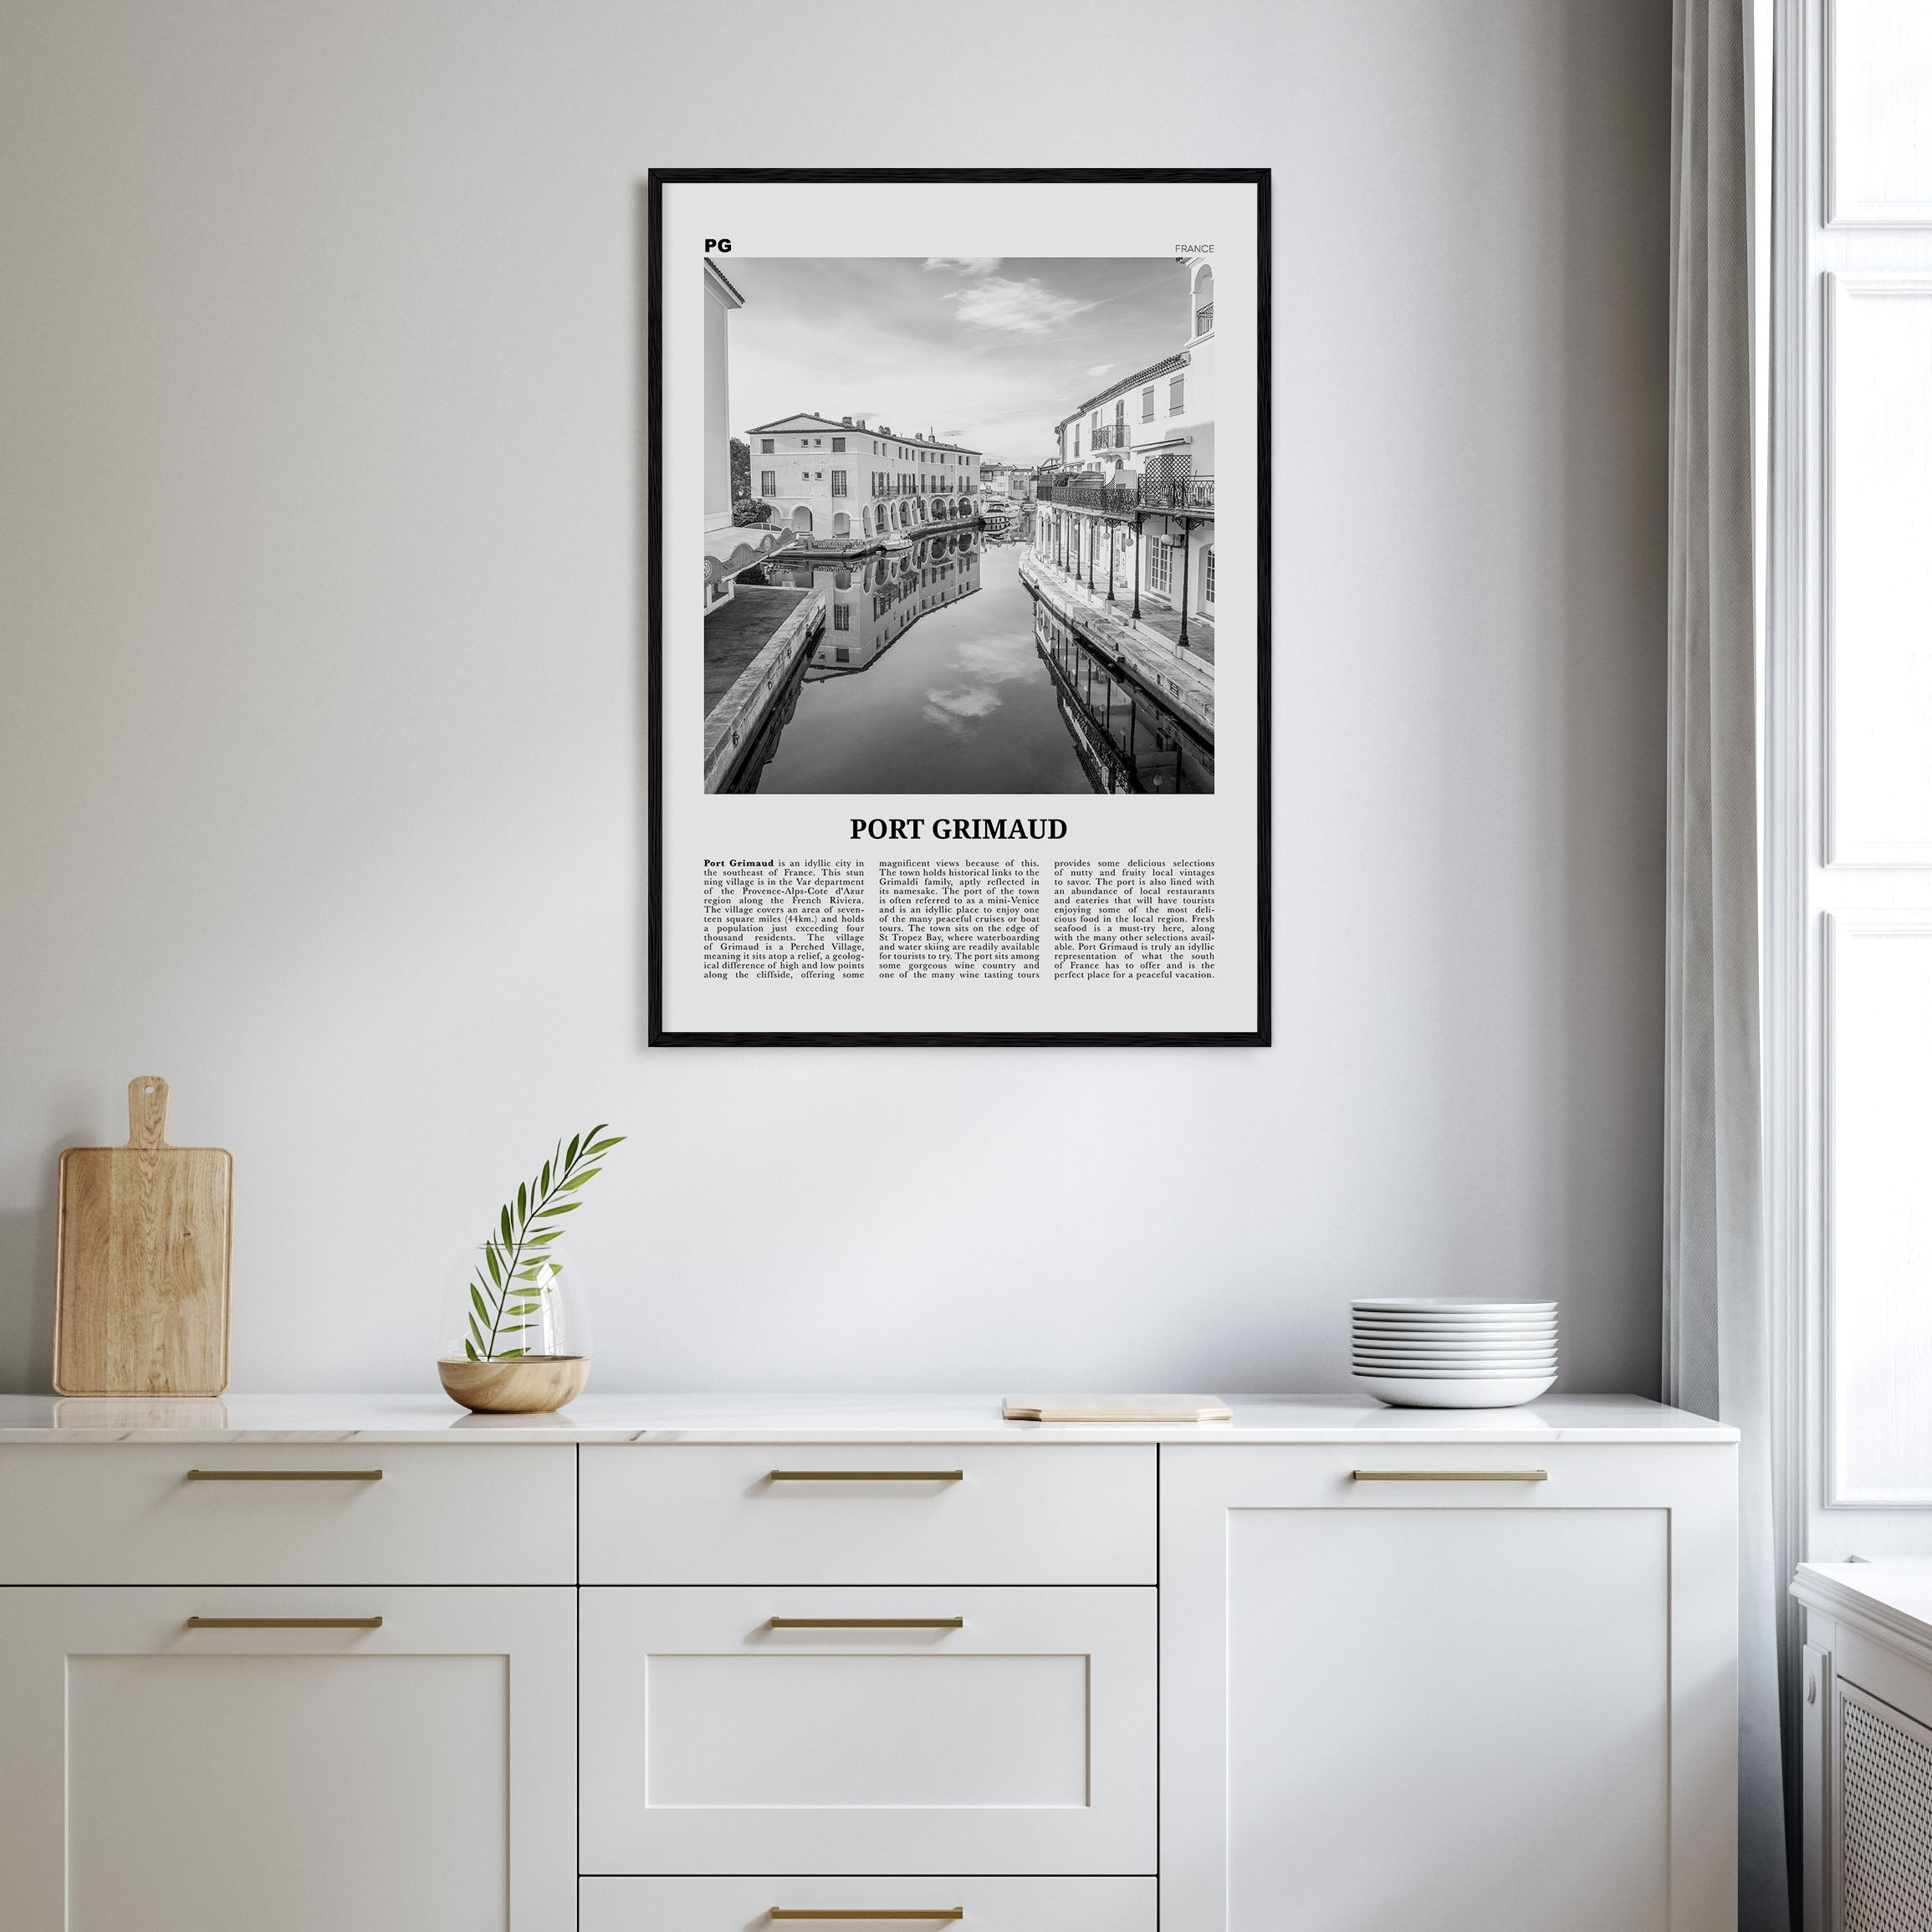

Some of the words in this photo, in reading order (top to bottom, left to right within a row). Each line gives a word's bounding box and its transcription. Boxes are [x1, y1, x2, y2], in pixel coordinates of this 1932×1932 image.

[704, 238, 732, 253] PG
[1174, 244, 1215, 253] FRANCE
[850, 818, 925, 840] PORT
[932, 818, 1068, 840] GRIMAUD
[703, 859, 725, 867] Port
[729, 859, 774, 867] Grimaud
[778, 859, 785, 867] is
[805, 859, 831, 869] idyllic
[835, 859, 851, 869] city
[856, 859, 864, 867] in
[879, 859, 930, 869] magnificent
[936, 859, 960, 867] views
[965, 859, 999, 867] because
[1005, 859, 1015, 867] of
[1021, 859, 1039, 867] this.
[1054, 859, 1091, 869] provides
[1127, 859, 1166, 867] delicious
[1173, 859, 1215, 867] selections
[704, 868, 718, 877] the
[723, 868, 763, 877] southeast
[768, 868, 779, 877] of
[784, 868, 815, 877] France.
[820, 868, 841, 877] This
[1054, 868, 1064, 877] of
[1071, 870, 1093, 878] nutty
[1099, 868, 1116, 877] and
[1122, 868, 1146, 878] fruity
[1153, 868, 1173, 877] local
[1179, 868, 1215, 878] vintages
[924, 878, 953, 887] family,
[959, 878, 981, 887] aptly
[703, 887, 713, 895] of
[721, 887, 735, 895] the
[743, 887, 828, 897] Provence-Alps-Cote
[835, 887, 865, 895] d'Azur
[879, 887, 890, 895] its
[893, 887, 938, 895] namesake.
[942, 887, 960, 895] The
[963, 888, 982, 897] port
[986, 887, 997, 895] of
[1000, 887, 1015, 895] the
[1071, 887, 1117, 895] abundance
[1123, 887, 1134, 895] of
[1140, 887, 1161, 895] local
[704, 897, 731, 906] region
[739, 897, 763, 906] along
[925, 906, 952, 915] idyllic
[956, 906, 979, 915] place
[996, 906, 1020, 915] enjoy
[785, 915, 817, 925] (44km.)
[1158, 915, 1188, 925] region.
[1005, 924, 1025, 934] edge
[1119, 926, 1156, 934] must-try
[1163, 924, 1184, 933] here,
[1191, 924, 1215, 934] along
[892, 933, 923, 943] Tropez
[926, 933, 943, 943] Bay,
[977, 933, 1040, 943] waterboarding
[831, 943, 865, 953] Village,
[1151, 943, 1172, 953] truly
[1188, 943, 1214, 953] idyllic
[879, 952, 892, 960] for
[893, 952, 926, 960] tourists
[938, 953, 953, 962] try.
[954, 952, 972, 960] The
[974, 953, 993, 962] port
[994, 952, 1009, 960] sits
[704, 961, 719, 969] ical
[722, 961, 764, 969] difference
[767, 961, 778, 969] of
[779, 961, 799, 971] high
[801, 961, 818, 969] and
[820, 961, 836, 969] low
[838, 961, 865, 971] points
[703, 970, 728, 980] along
[735, 970, 749, 979] the
[756, 970, 793, 979] cliffside,
[800, 970, 835, 980] offering
[898, 970, 909, 979] of
[913, 970, 927, 979] the
[959, 970, 979, 979] wine
[984, 970, 1014, 980] tasting
[1054, 970, 1084, 980] perfect
[1087, 970, 1110, 980] place
[1113, 970, 1126, 979] for
[1136, 970, 1173, 980] peaceful
[1175, 970, 1214, 979] vacation.
